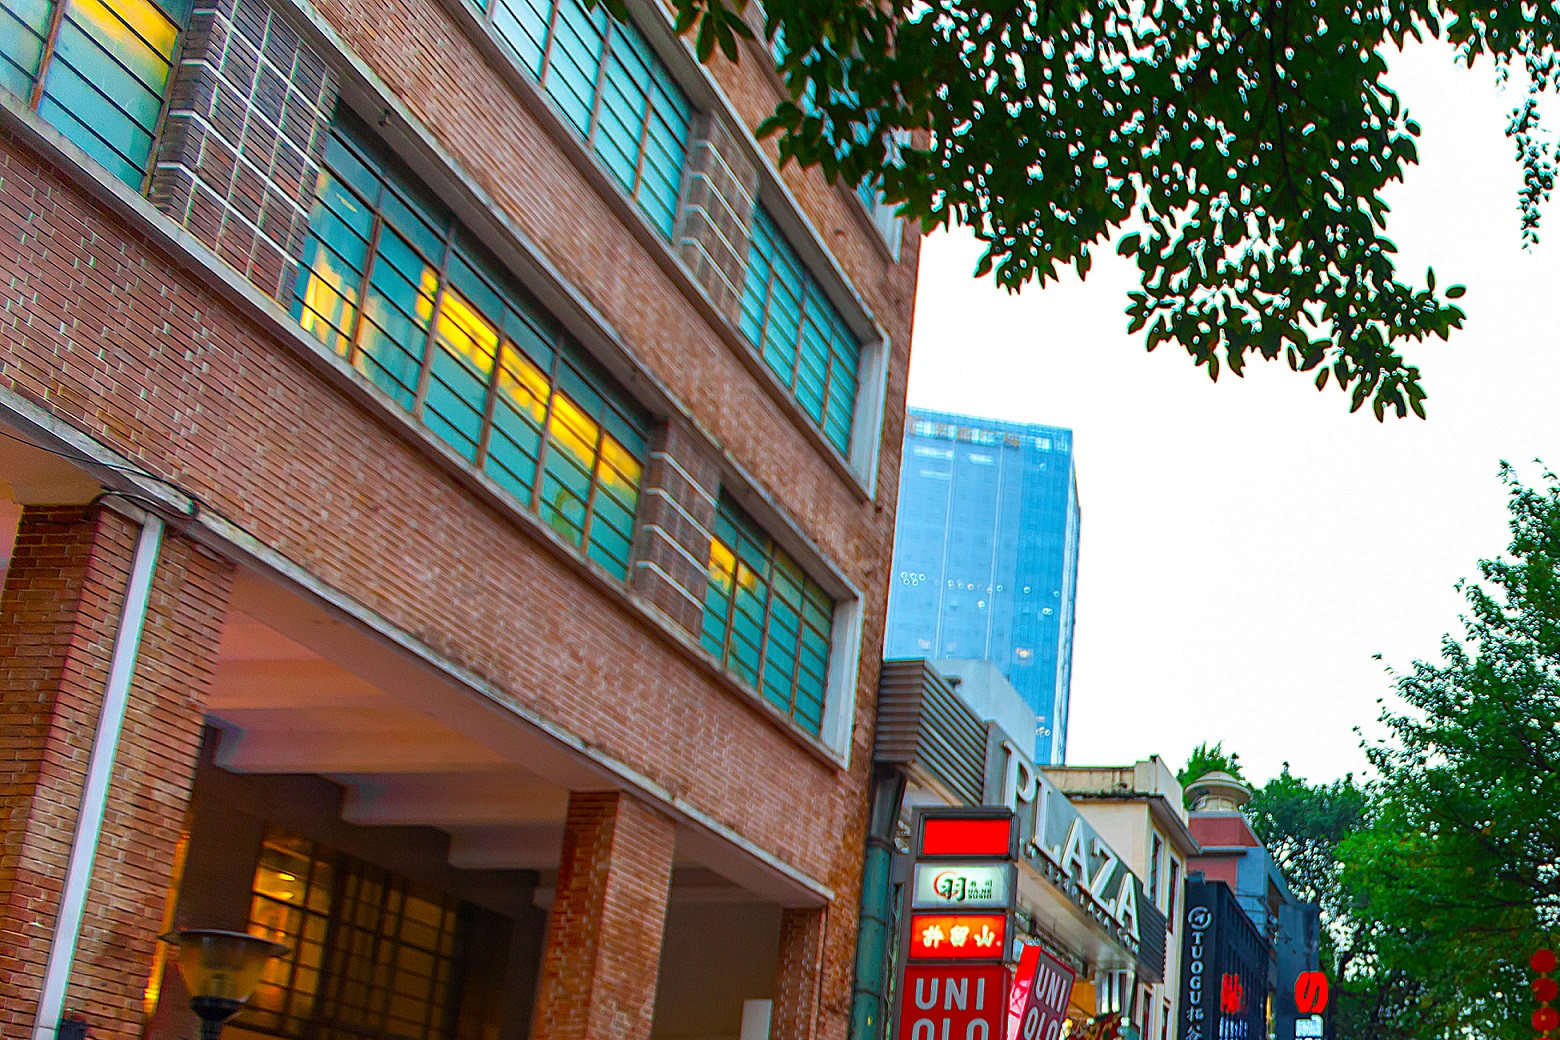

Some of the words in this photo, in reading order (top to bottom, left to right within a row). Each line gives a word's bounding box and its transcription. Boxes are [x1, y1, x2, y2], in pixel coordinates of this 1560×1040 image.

[1001, 738, 1141, 943] PLAZA
[915, 977, 985, 1011] UNI
[1035, 963, 1068, 1013] UNI
[1190, 931, 1205, 1005] TUOGU
